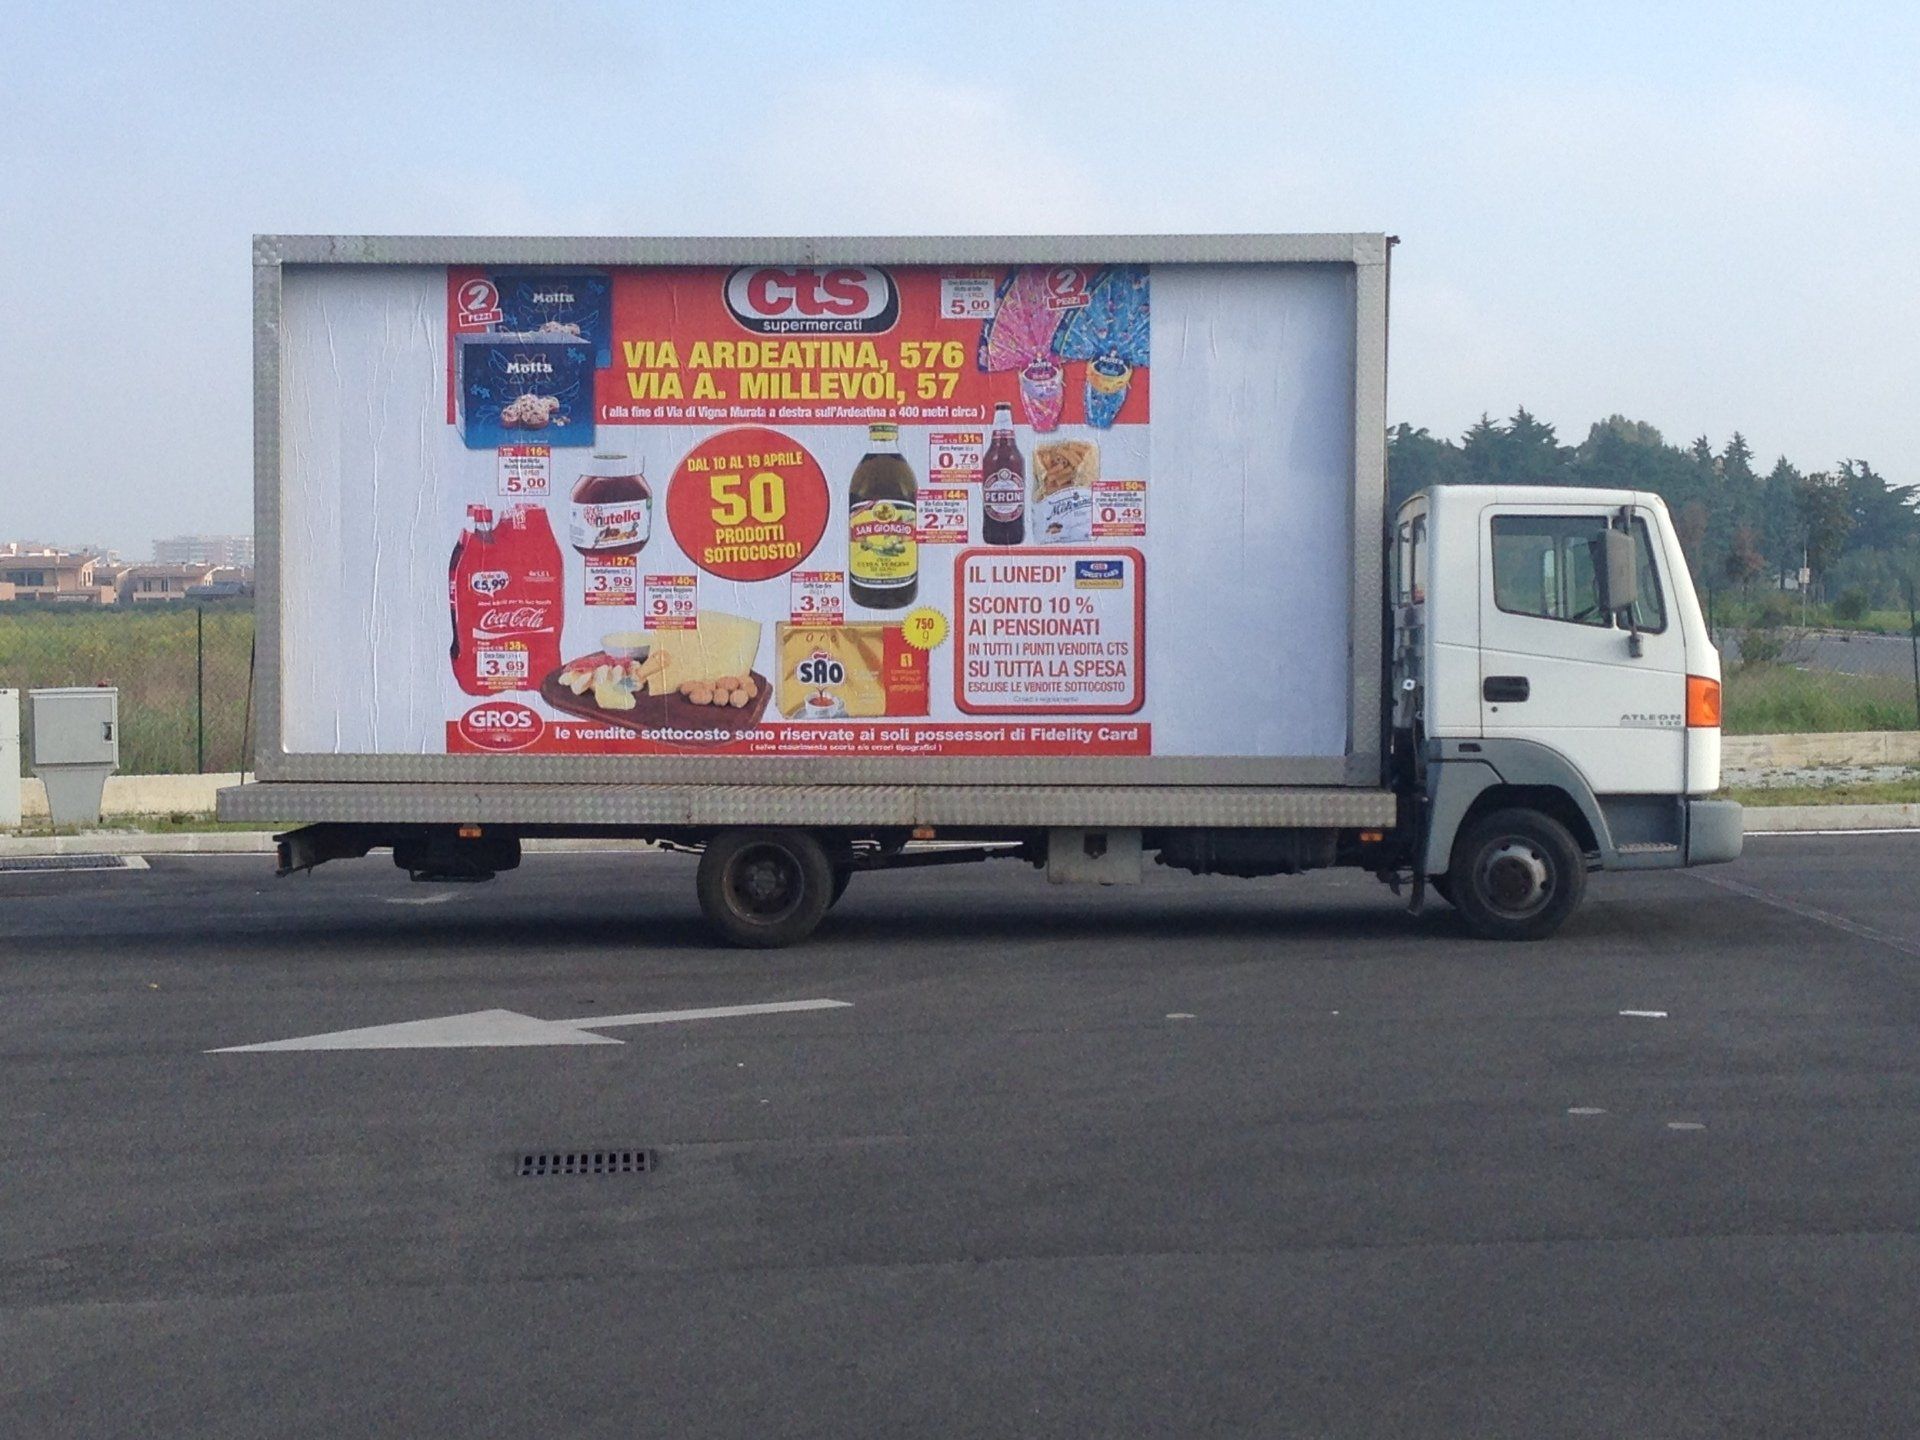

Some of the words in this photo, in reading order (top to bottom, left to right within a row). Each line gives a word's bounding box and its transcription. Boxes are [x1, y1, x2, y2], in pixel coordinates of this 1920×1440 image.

[1055, 269, 1077, 294] 2
[467, 284, 490, 311] 2
[532, 292, 576, 304] Motta
[763, 318, 863, 332] supermercati
[623, 341, 680, 368] VIA
[688, 341, 889, 374] ARDEATINA,
[900, 341, 965, 369] 576
[506, 362, 553, 374] Motta
[627, 372, 684, 399] VIA
[692, 372, 726, 399] A.
[739, 372, 906, 405] MILLEVOI,
[917, 372, 959, 399] 57
[610, 406, 628, 418] alla
[631, 406, 652, 418] fine
[654, 406, 664, 418] di
[666, 406, 683, 418] Via
[686, 406, 695, 418] di
[698, 406, 727, 420] Vigna
[730, 406, 766, 418] Murata
[769, 408, 776, 418] a
[778, 406, 811, 418] destra
[889, 408, 896, 418] a
[899, 406, 919, 418] 400
[921, 406, 949, 418] metri
[951, 406, 978, 418] circa
[687, 457, 710, 472] DAL
[713, 457, 726, 470] 10
[729, 456, 744, 469] AL
[747, 454, 759, 468] 19
[763, 451, 803, 467] APRILE
[507, 477, 546, 492] 5,00
[710, 472, 786, 525] 50
[595, 509, 641, 527] nutella
[924, 513, 964, 529] 2,79
[715, 525, 785, 545] PRODOTTI
[874, 524, 911, 535] GIORGIO
[704, 542, 801, 563] SOTTOCOSTO!
[968, 565, 986, 583] IL
[992, 565, 1067, 583] LUNEDI'
[800, 596, 840, 611] 3,99
[968, 597, 1042, 614] SCONTO
[1049, 598, 1070, 613] 10
[1075, 597, 1094, 614] %
[915, 618, 934, 630] 750
[968, 619, 987, 636] AI
[993, 619, 1100, 636] PENSIONATI
[968, 643, 980, 656] IN
[983, 643, 1013, 656] TUTTI
[1023, 643, 1055, 656] PUNTI
[1058, 643, 1104, 655] VENDITA
[1107, 643, 1129, 655] CTS
[968, 660, 990, 678] SU
[994, 660, 1044, 677] TUTTA
[1049, 660, 1069, 677] LA
[1074, 660, 1127, 677] SPESA
[968, 682, 1008, 692] ESCLUSE
[1011, 682, 1021, 692] LE
[1024, 682, 1061, 692] VENDITE
[1064, 682, 1125, 692] SOTTOCOSTO
[468, 711, 532, 727] GROS
[555, 727, 570, 740] le
[576, 727, 636, 740] vendite
[641, 727, 730, 740] sottocosto
[735, 729, 775, 741] sono
[780, 728, 854, 741] riservate
[860, 728, 874, 741] ai
[880, 728, 910, 741] soli
[914, 728, 1005, 744] possessori
[1010, 728, 1025, 741] di
[1031, 728, 1093, 744] Fidelity
[1097, 728, 1138, 741] Card
